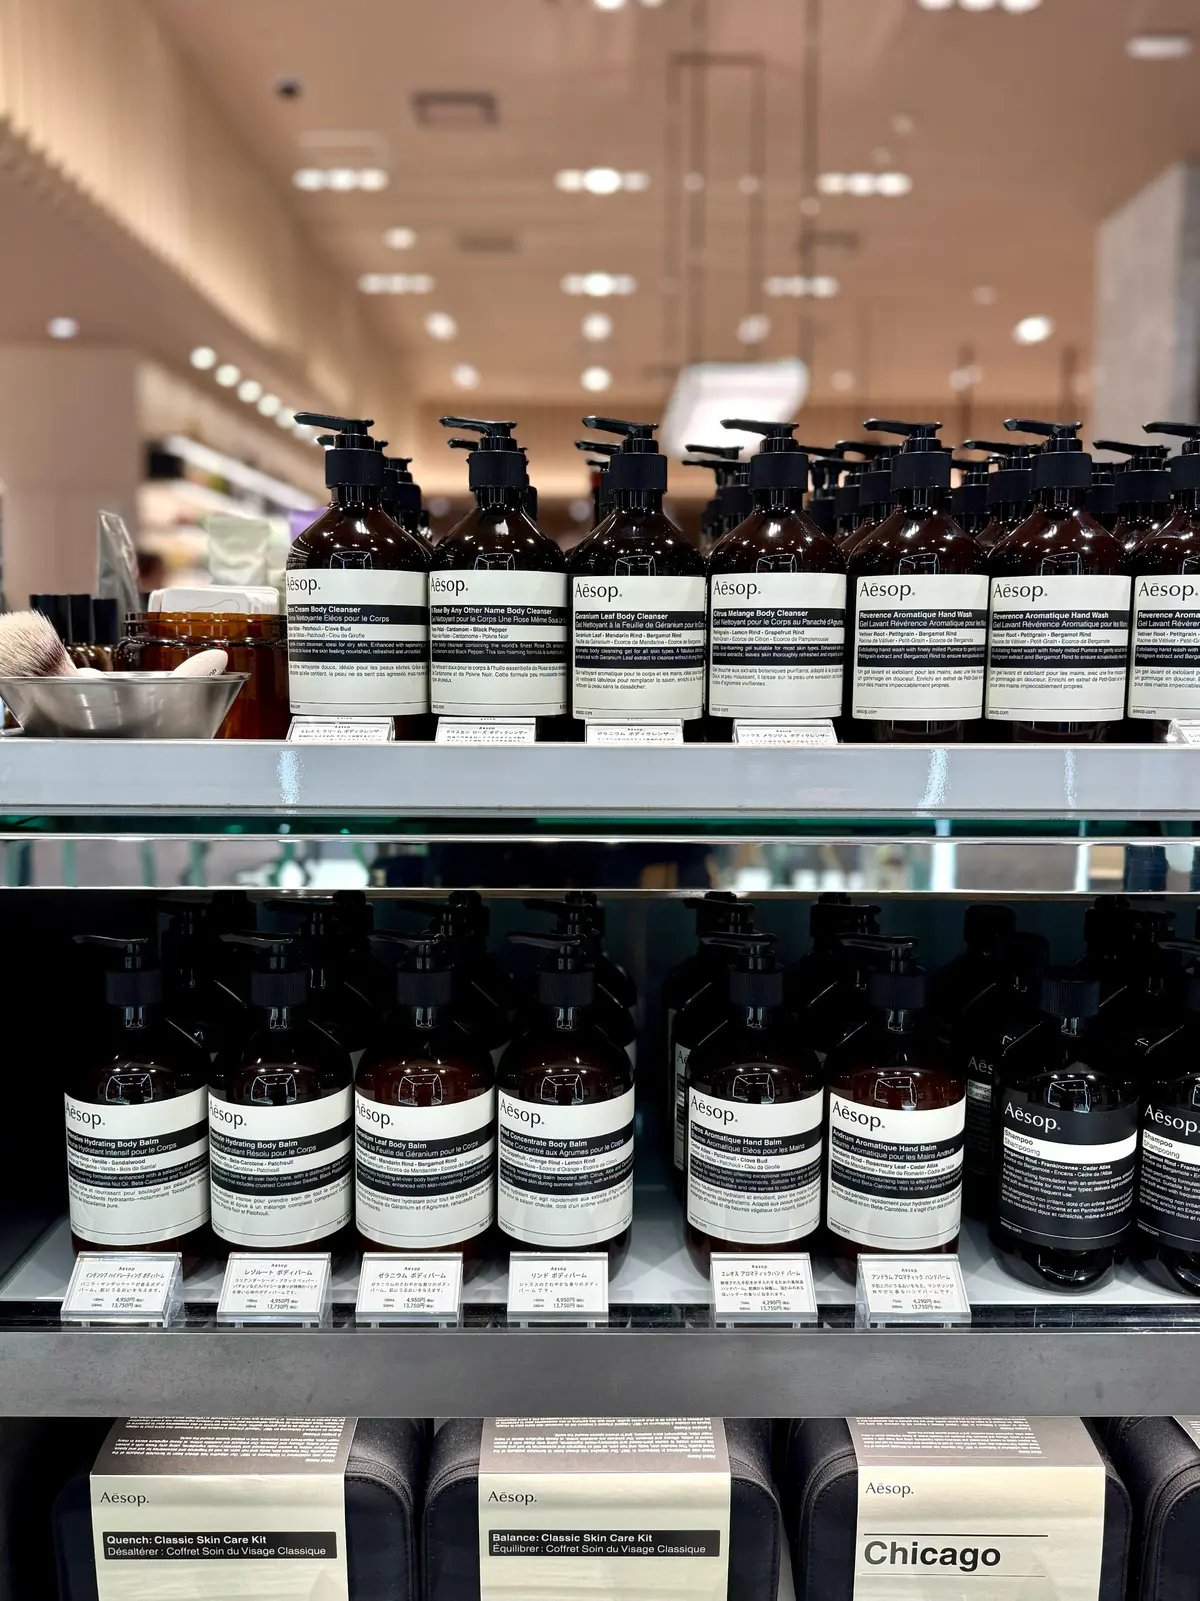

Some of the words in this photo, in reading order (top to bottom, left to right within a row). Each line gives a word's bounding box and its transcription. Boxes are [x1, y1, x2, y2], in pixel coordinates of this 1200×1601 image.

[575, 583, 622, 602] Aēsop.
[713, 581, 761, 599] Aēsop.
[860, 582, 915, 601] Aēsop.
[994, 583, 1047, 602] Aēsop.
[1139, 582, 1198, 600] Aēsop.
[507, 607, 525, 615] Body
[728, 610, 754, 618] Melange
[370, 615, 389, 623] Corps
[500, 1098, 545, 1128] Aēsop.
[691, 1095, 738, 1125] Aēsop.
[833, 1101, 885, 1131] Aēsop.
[1004, 1102, 1061, 1133] Aēsop.
[84, 1138, 115, 1148] Hydrating
[140, 1138, 159, 1146] Balm
[225, 1137, 255, 1149] Hydrating
[257, 1141, 276, 1149] Body
[278, 1140, 298, 1148] Balm
[375, 1137, 387, 1145] Leaf
[388, 1140, 406, 1149] Body
[510, 1131, 547, 1146] Concentrate
[548, 1141, 567, 1149] Body
[704, 1130, 741, 1145] Aromatique
[833, 1129, 854, 1143] Andrum
[856, 1139, 897, 1152] Aromatique
[1004, 1129, 1034, 1145] Shampoo
[1144, 1132, 1173, 1148] Shampoo
[105, 1147, 130, 1156] Intensif
[157, 1143, 177, 1152] Corps
[707, 1139, 740, 1153] Aromatique
[789, 1144, 805, 1152] Mains
[851, 1144, 887, 1159] Aromatique
[1004, 1138, 1041, 1156] Shampooing
[1144, 1139, 1180, 1159] Shampooing
[865, 1482, 914, 1497] Aēsop.
[100, 1492, 150, 1506] Aēsop.
[488, 1491, 537, 1505] Aēsop.
[107, 1535, 152, 1545] Quench:
[154, 1535, 194, 1544] Classic
[196, 1535, 221, 1544] Skin
[223, 1535, 249, 1544] Care
[251, 1536, 267, 1544] Kit
[493, 1534, 539, 1542] Balance:
[541, 1534, 581, 1542] Classic
[583, 1534, 606, 1542] Skin
[609, 1534, 635, 1542] Care
[637, 1534, 653, 1542] Kit
[108, 1545, 159, 1556] Désaltérer
[166, 1546, 200, 1556] Coffret
[202, 1546, 224, 1556] Soin
[226, 1547, 240, 1556] du
[242, 1547, 275, 1558] Visage
[278, 1547, 326, 1557] Classique
[493, 1543, 539, 1555] Équilibrer
[546, 1544, 579, 1554] Coffret
[582, 1544, 604, 1554] Soin
[606, 1544, 619, 1554] du
[621, 1545, 655, 1555] Visage
[657, 1545, 706, 1555] Classique
[864, 1540, 1001, 1572] Chicago
